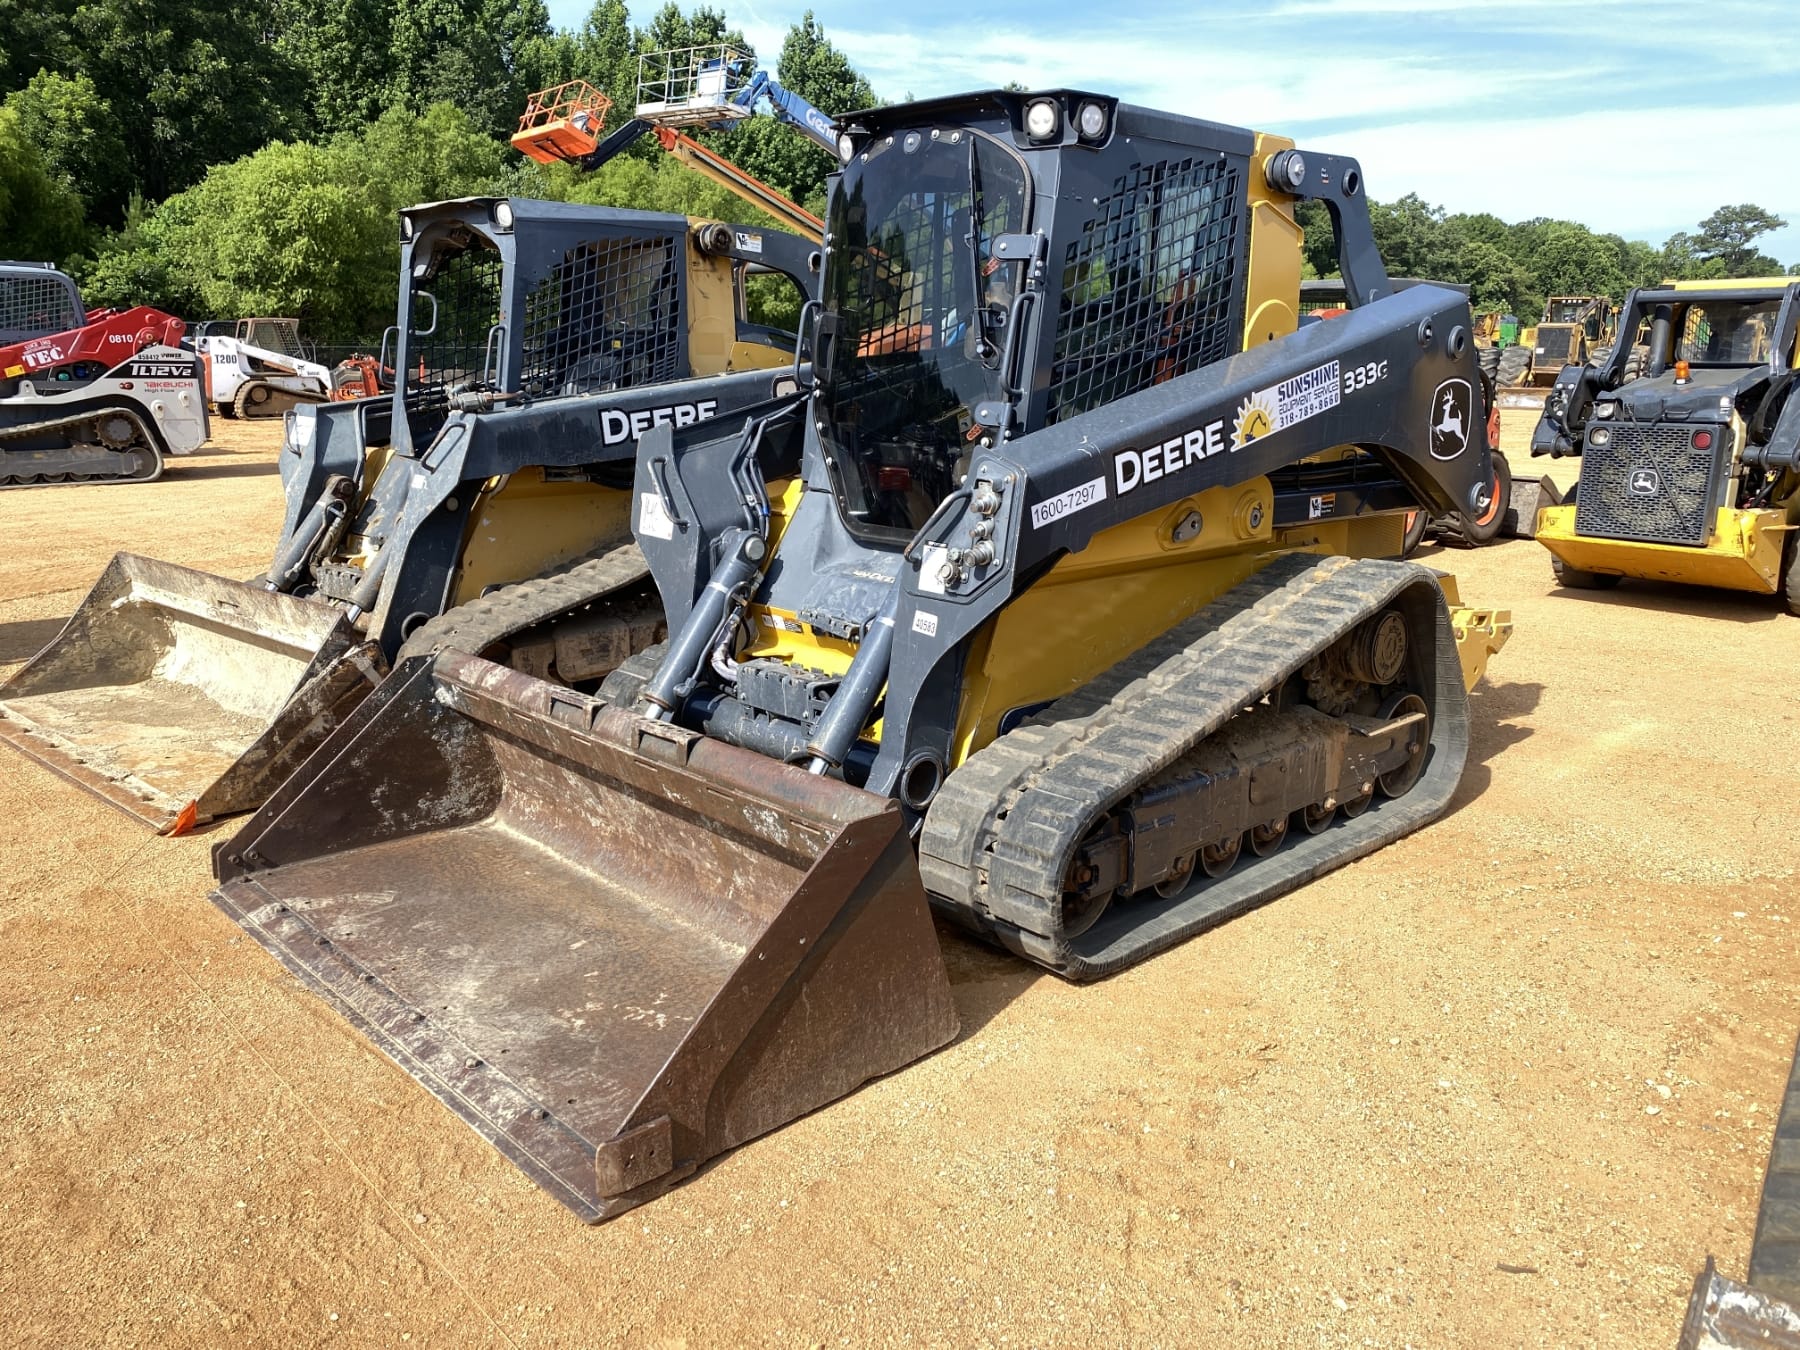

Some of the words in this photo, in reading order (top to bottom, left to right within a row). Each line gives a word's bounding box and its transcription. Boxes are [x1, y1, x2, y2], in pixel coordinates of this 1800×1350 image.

[805, 108, 838, 145] Geni
[21, 346, 65, 368] TEC
[109, 334, 133, 344] 0810
[214, 354, 237, 364] T200
[1278, 362, 1339, 402] SUNSHINE
[1279, 391, 1312, 415] EQUIPMENT
[1313, 380, 1339, 400] SERVICES
[1279, 392, 1339, 428] 318-789-8660
[1114, 421, 1225, 496] DEERE
[1034, 484, 1096, 523] 1600-7297
